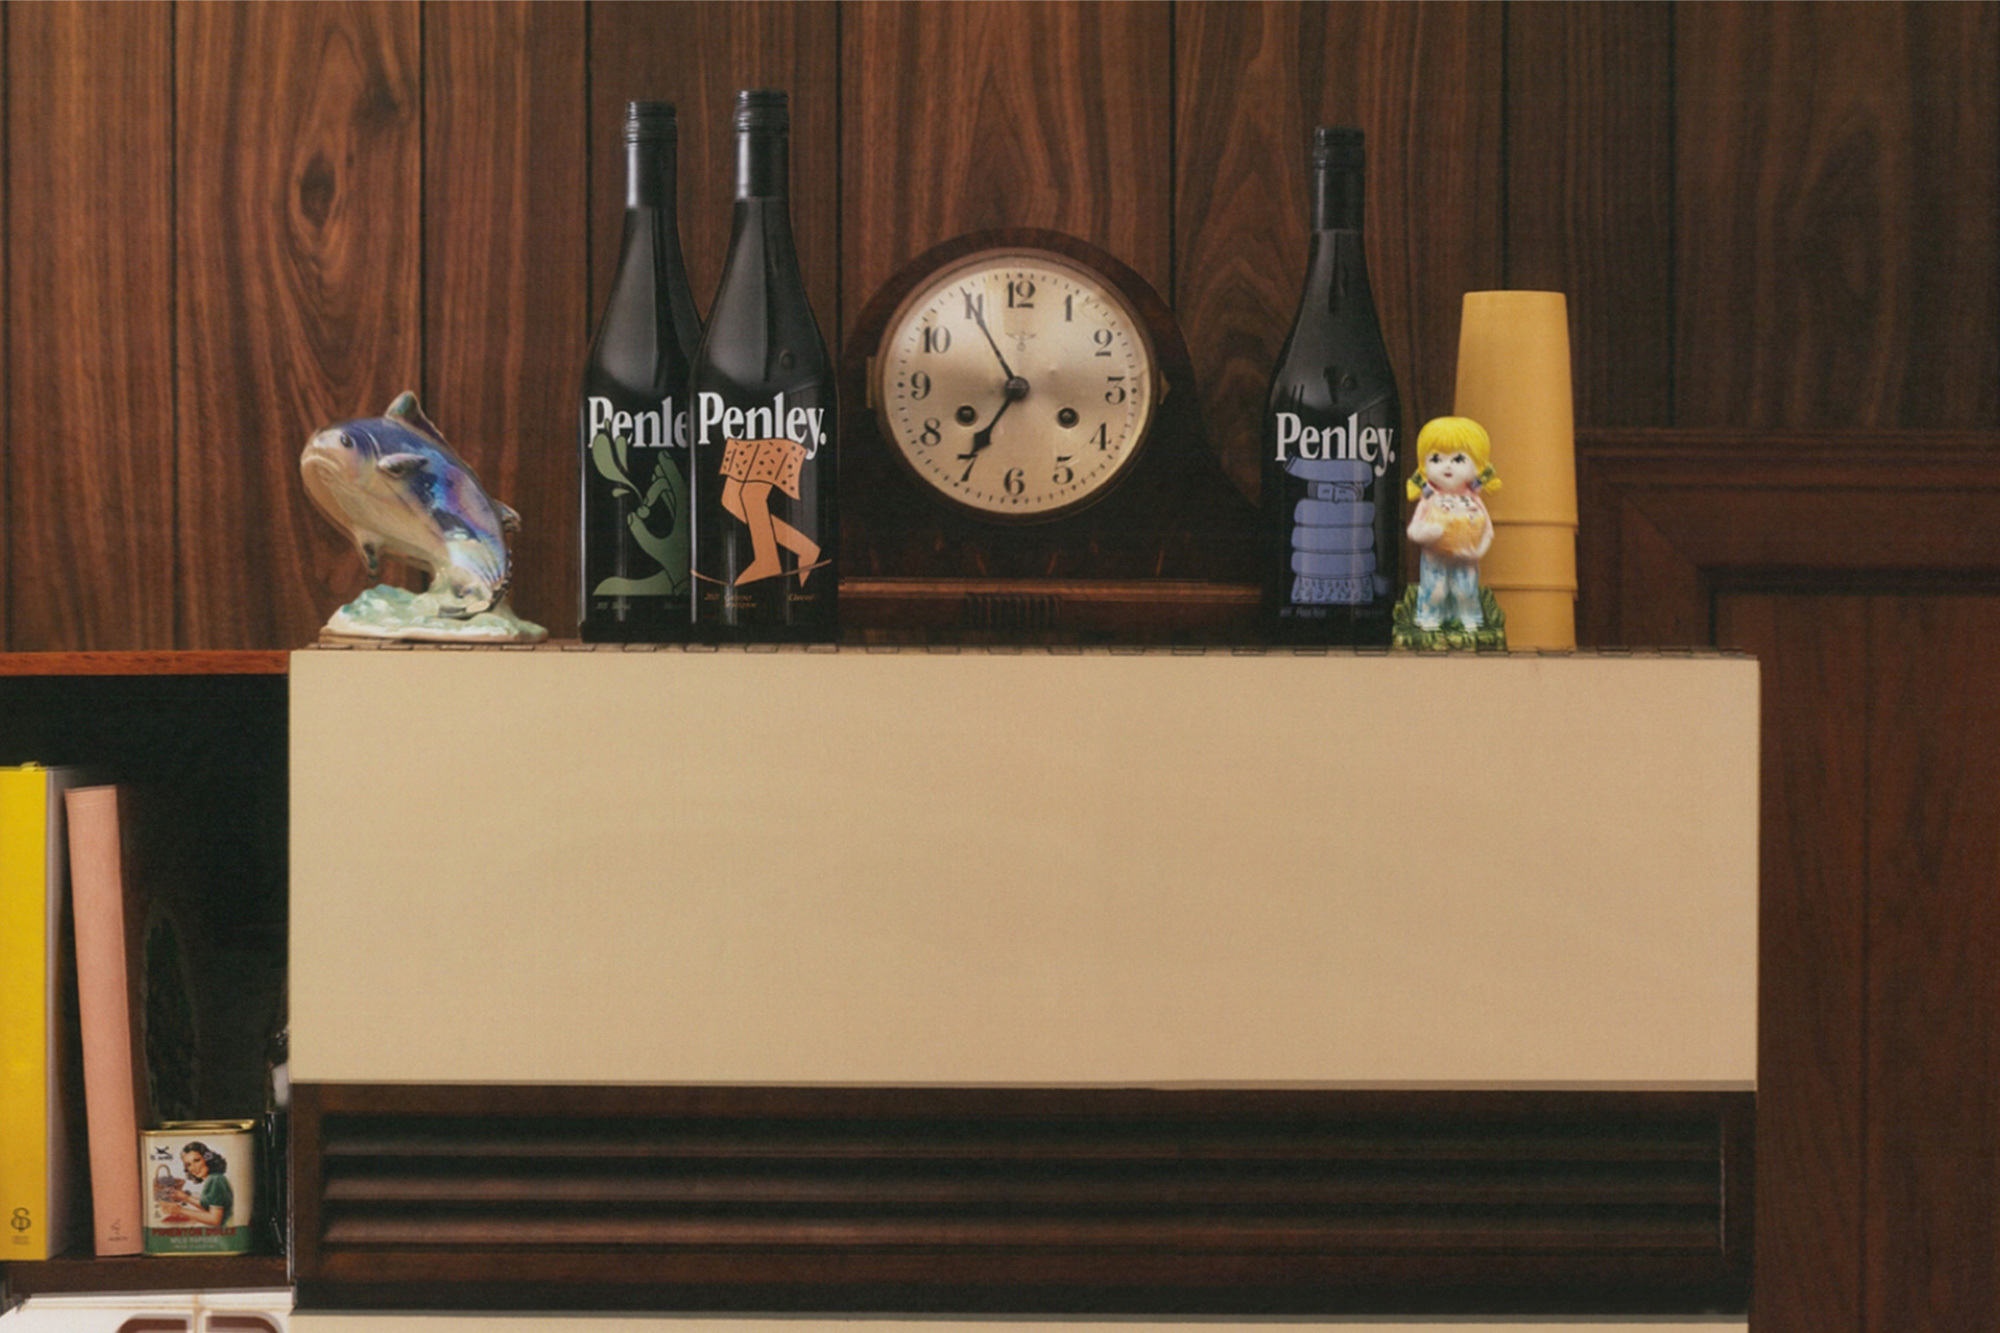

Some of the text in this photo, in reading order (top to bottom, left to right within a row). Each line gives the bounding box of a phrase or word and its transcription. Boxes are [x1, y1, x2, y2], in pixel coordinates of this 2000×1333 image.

[1006, 280, 1036, 309] 12
[1063, 294, 1073, 322] 1
[922, 326, 951, 354] 10
[1094, 328, 1113, 357] 2
[910, 371, 931, 400] 9
[1105, 376, 1126, 404] 3
[698, 391, 827, 460] Penley.
[920, 418, 942, 446] 8
[1089, 422, 1112, 451] 4
[1274, 411, 1395, 477] Penley.
[957, 453, 978, 482] 7
[1003, 467, 1025, 496] 6
[1053, 456, 1074, 485] 5
